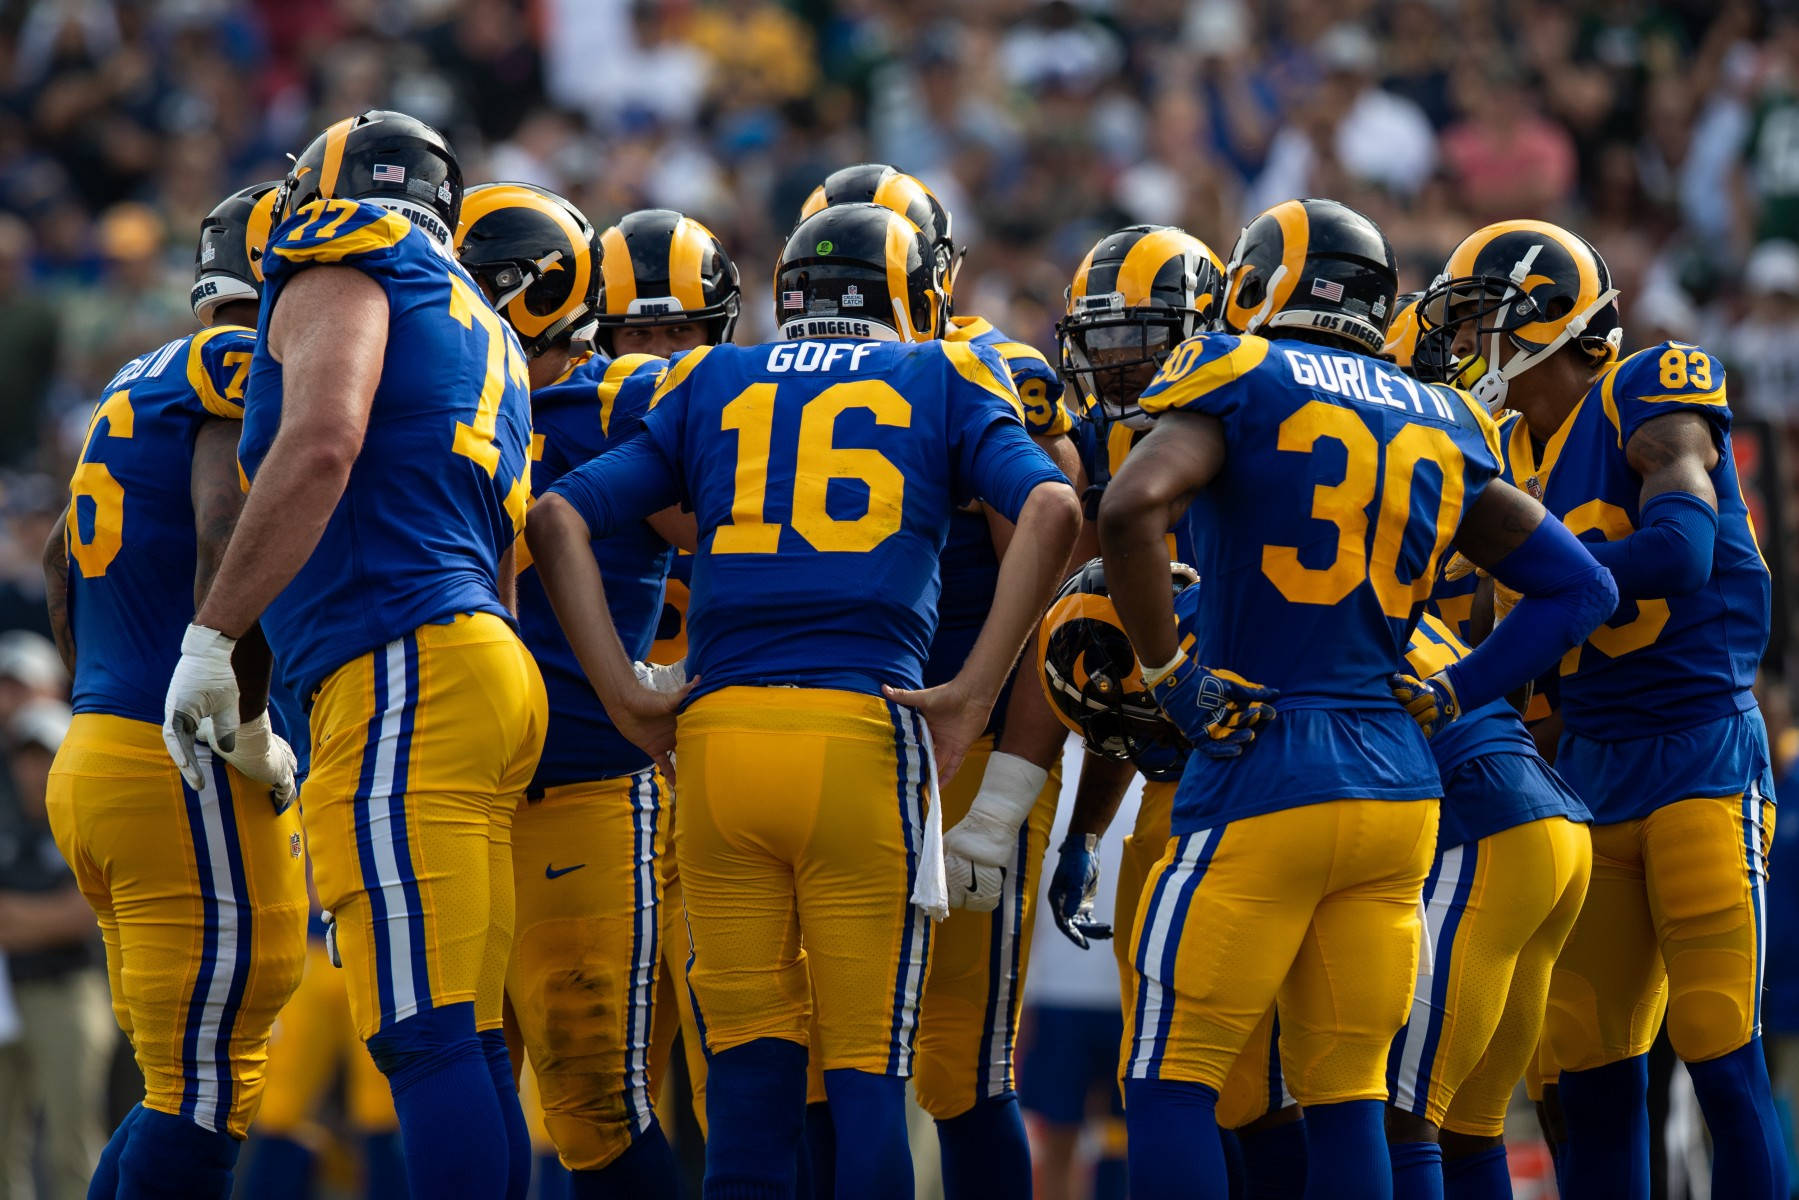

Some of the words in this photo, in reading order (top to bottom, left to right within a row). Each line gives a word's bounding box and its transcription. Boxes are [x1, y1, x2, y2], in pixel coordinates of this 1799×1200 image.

[287, 199, 360, 241] 77
[786, 324, 804, 340] LOS
[808, 322, 870, 337] ANGELES
[1312, 314, 1340, 329] LOS
[223, 352, 253, 399] 7
[765, 342, 881, 372] GOFF
[1150, 341, 1203, 386] 30
[1659, 349, 1712, 390] 83
[1284, 350, 1425, 413] GURLEY
[710, 379, 912, 554] 16
[1260, 400, 1466, 620] 30
